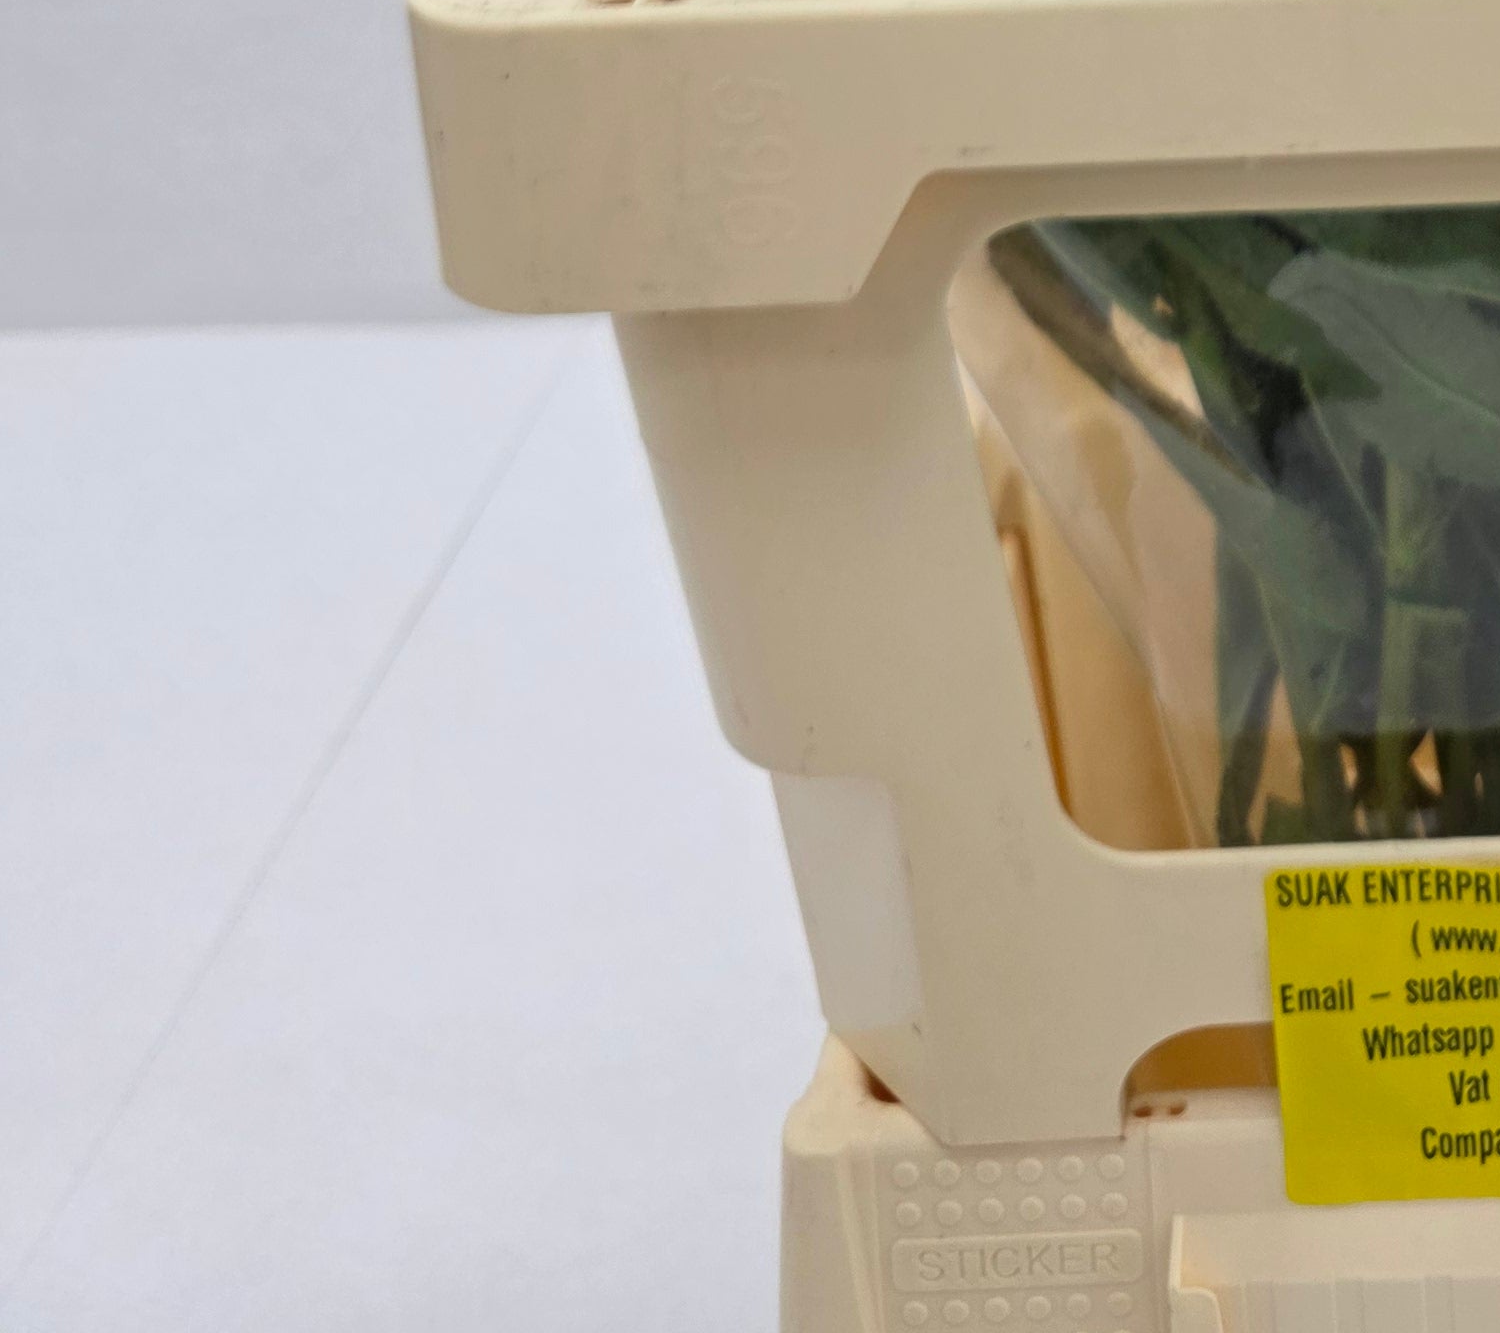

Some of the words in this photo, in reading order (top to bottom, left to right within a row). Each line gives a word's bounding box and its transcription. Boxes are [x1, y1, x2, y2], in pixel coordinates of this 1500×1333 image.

[1273, 870, 1352, 910] SUAK
[1279, 978, 1355, 1016] Email
[1362, 1022, 1495, 1062] Whatsapp
[1448, 1069, 1491, 1107] Vat
[917, 1241, 1121, 1282] STICKER
